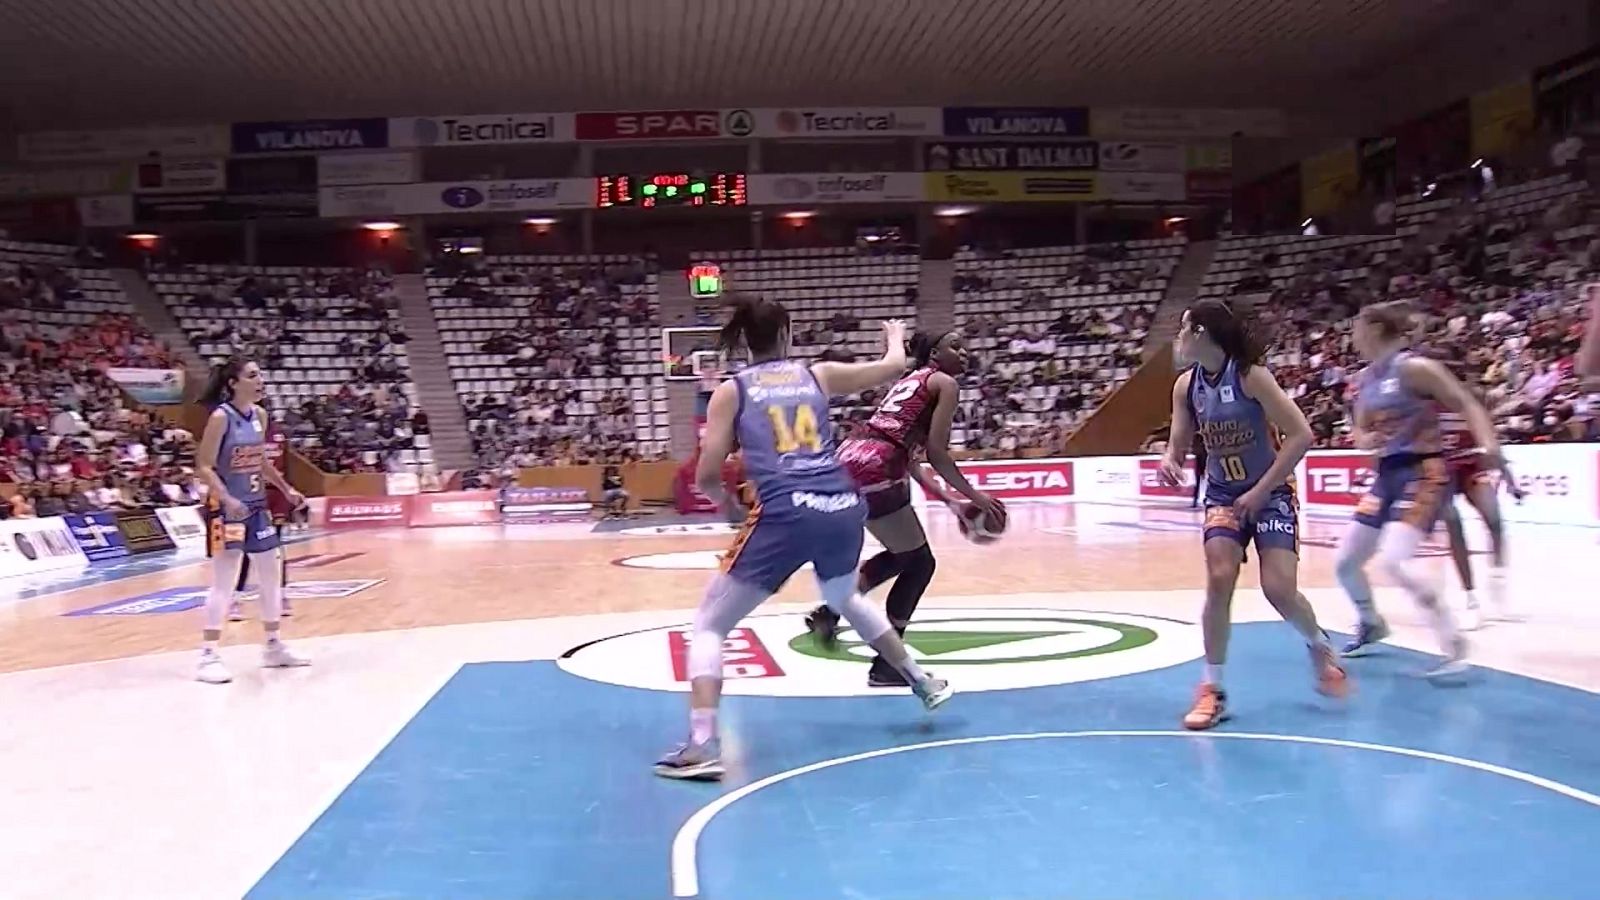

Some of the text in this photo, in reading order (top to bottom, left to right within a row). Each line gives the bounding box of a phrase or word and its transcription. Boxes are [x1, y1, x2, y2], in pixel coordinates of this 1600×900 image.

[443, 115, 554, 141] Tecnical
[615, 113, 720, 135] SPAR
[803, 112, 896, 132] Tecnical
[966, 117, 1068, 135] VILANOVA
[255, 128, 366, 149] VILANOVA
[956, 148, 1007, 168] SANT
[768, 404, 823, 453] 14
[1220, 455, 1247, 481] 10
